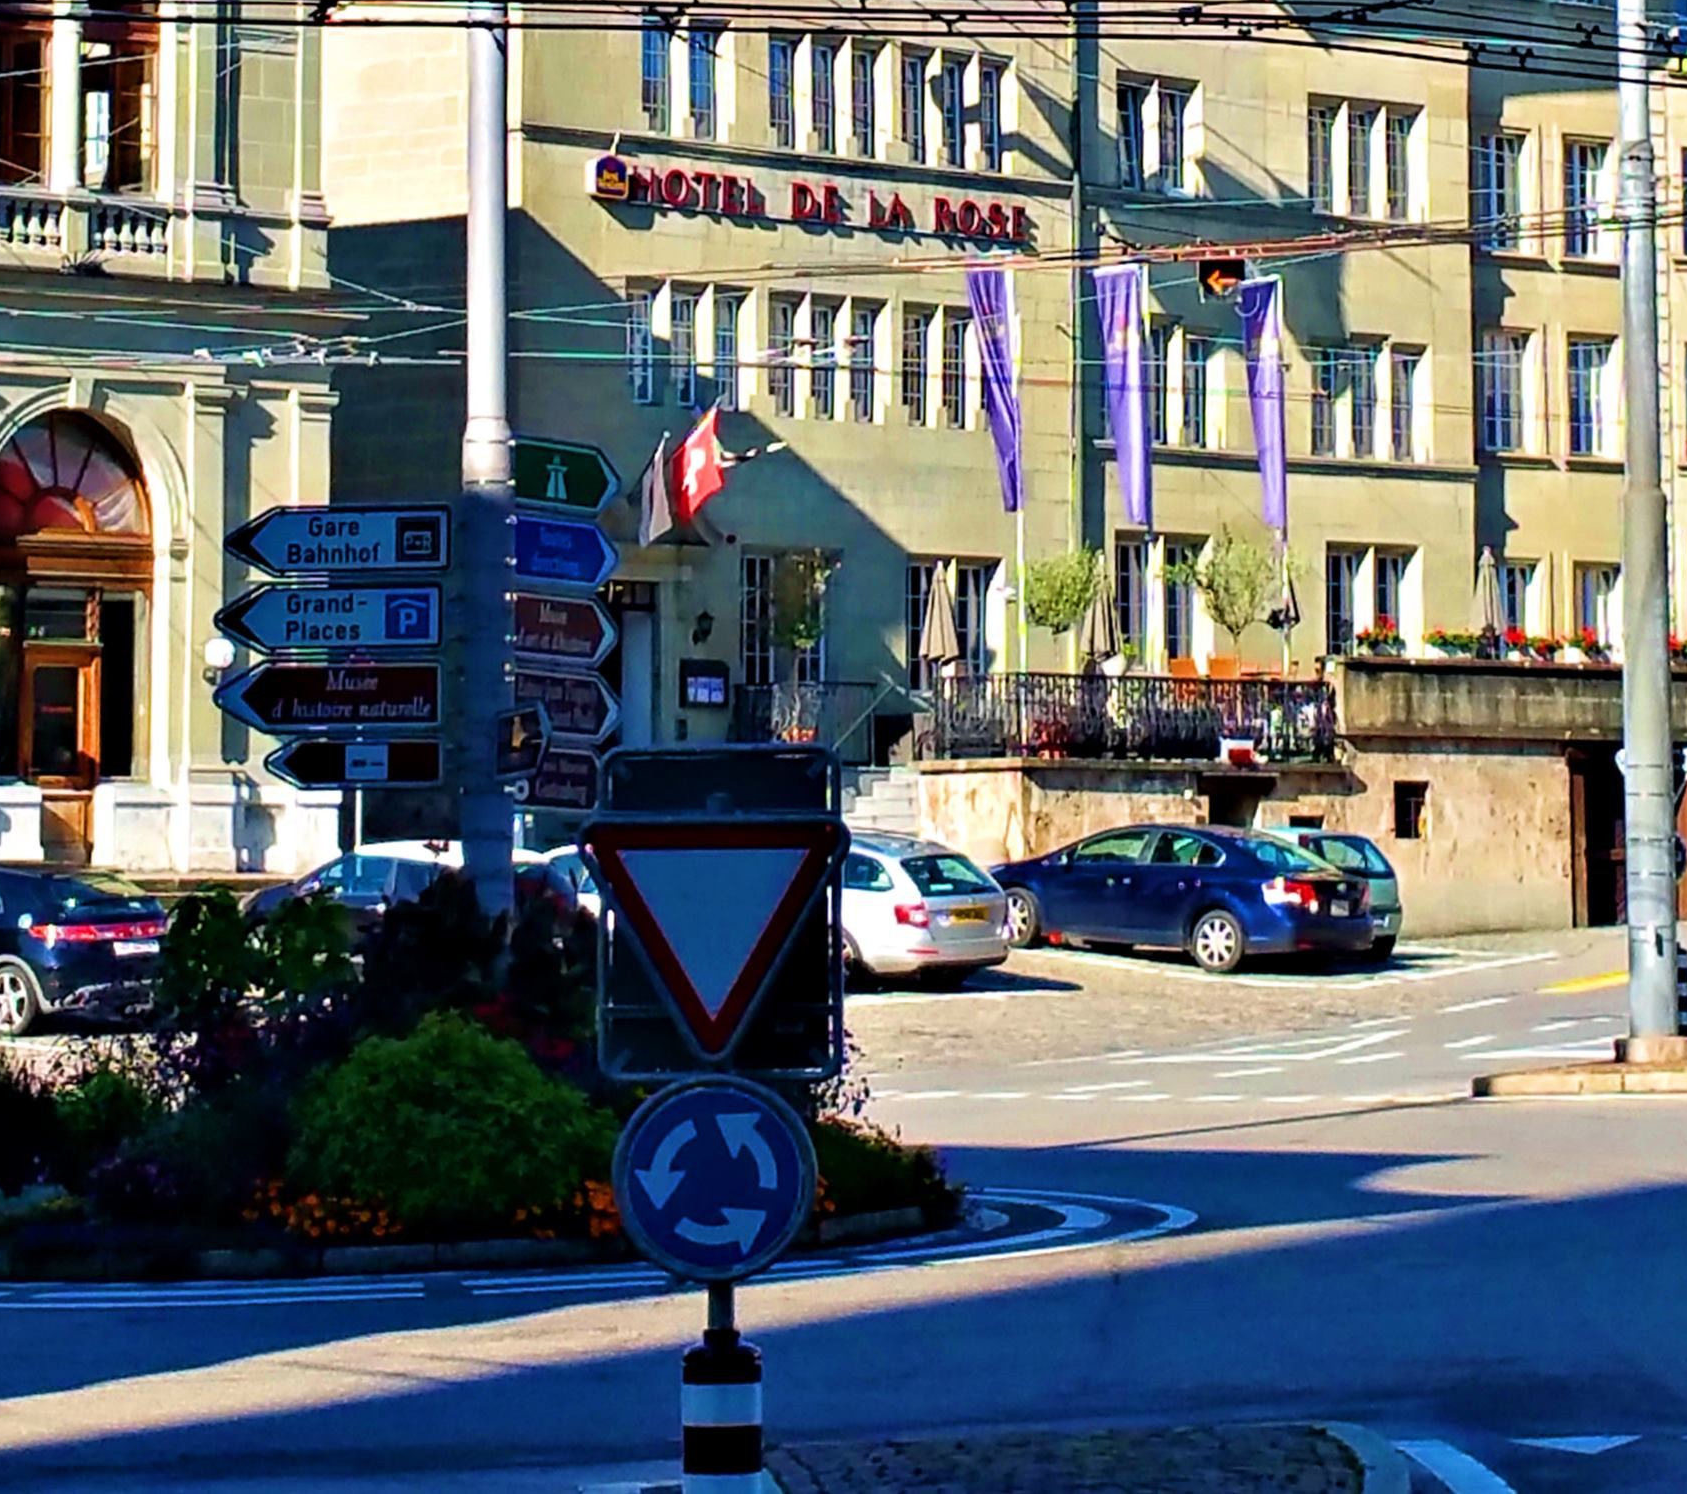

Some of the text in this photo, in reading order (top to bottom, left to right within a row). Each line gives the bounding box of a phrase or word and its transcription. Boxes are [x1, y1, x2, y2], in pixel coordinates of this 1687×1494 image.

[633, 165, 766, 216] HOTEL
[791, 181, 841, 225] DE
[869, 190, 911, 228] LA
[933, 197, 1028, 242] ROSE
[308, 517, 360, 536] Gare
[286, 542, 381, 564] Bahnhof
[286, 593, 368, 614] Grand-
[285, 621, 361, 641] Places
[359, 696, 432, 717] naturelle
